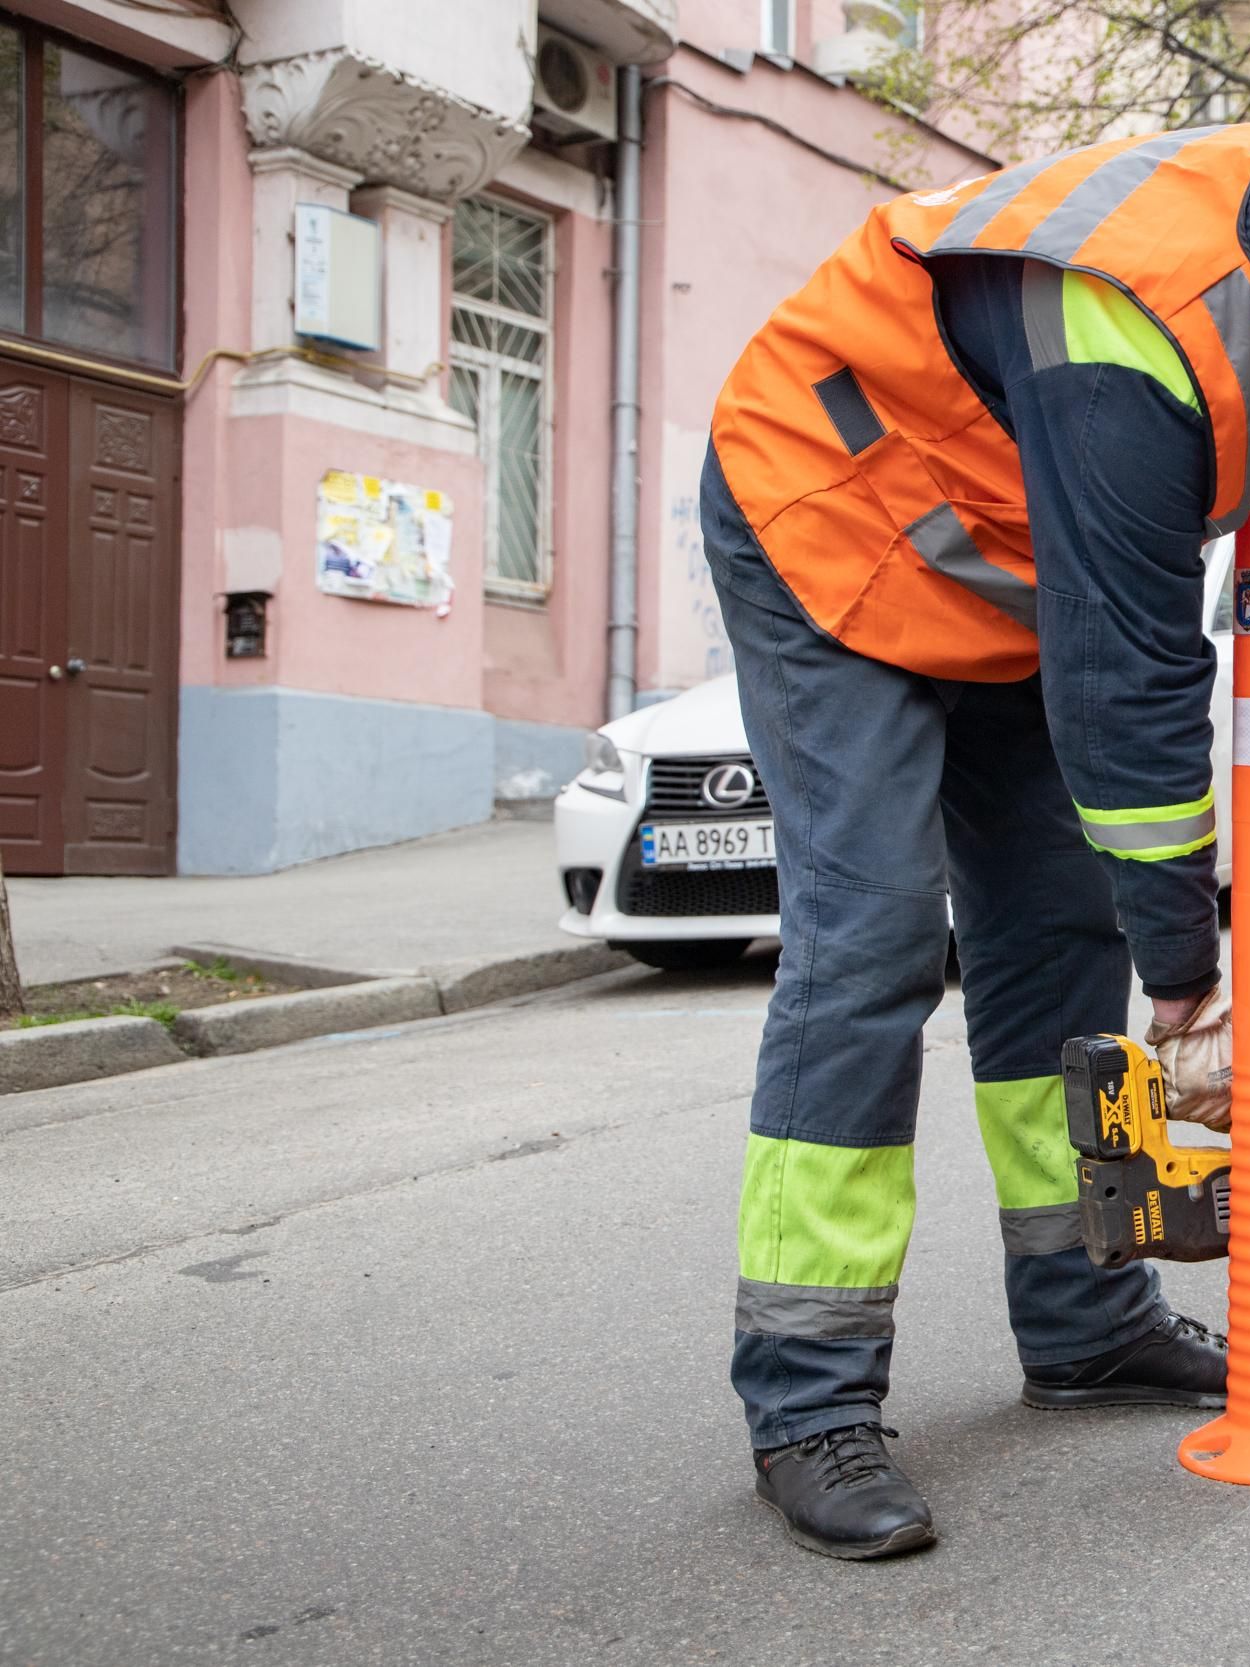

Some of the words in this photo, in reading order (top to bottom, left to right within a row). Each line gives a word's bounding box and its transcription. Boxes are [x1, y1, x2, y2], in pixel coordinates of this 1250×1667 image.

[658, 831, 689, 857] AA
[696, 827, 749, 856] 8969
[757, 825, 772, 853] T
[1107, 1081, 1115, 1095] 18V
